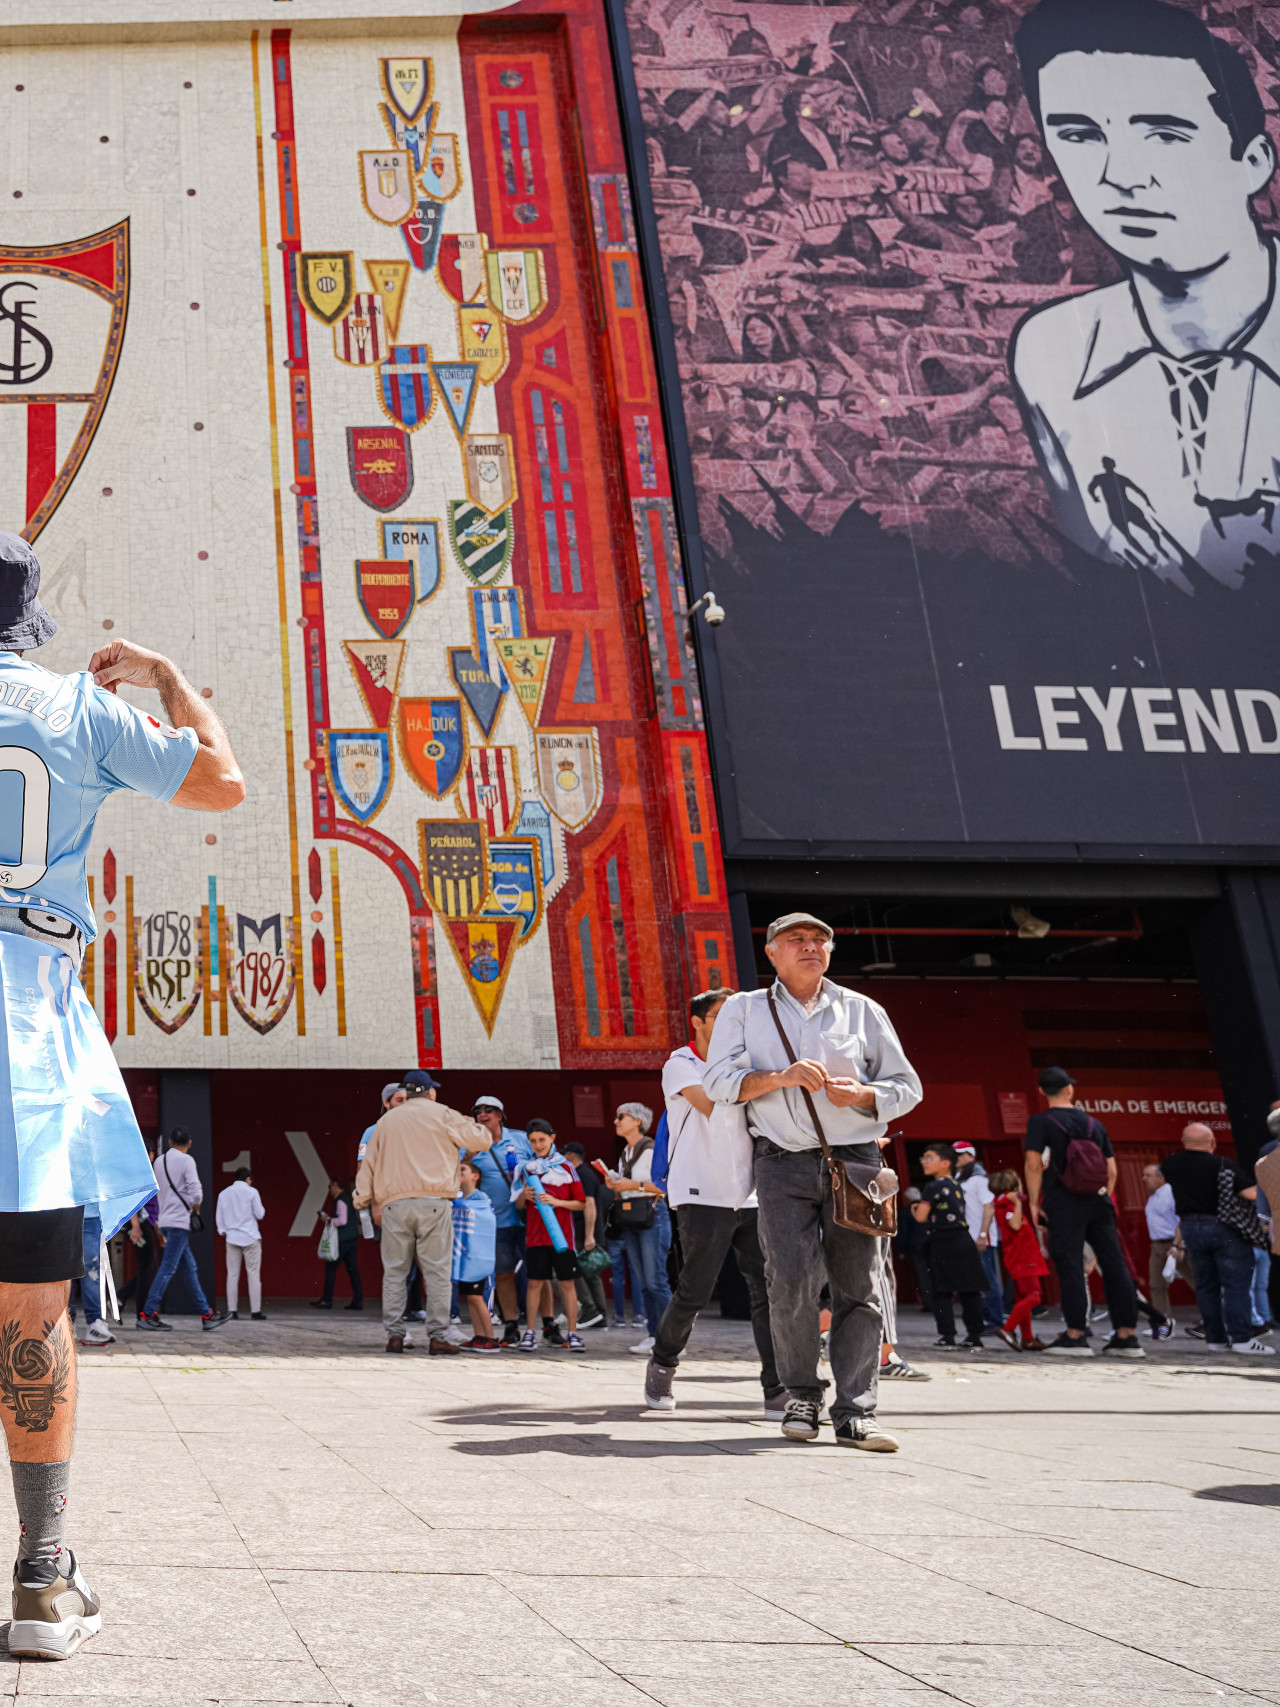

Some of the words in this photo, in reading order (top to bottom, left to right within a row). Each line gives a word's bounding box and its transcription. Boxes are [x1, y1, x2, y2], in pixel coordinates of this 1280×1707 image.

[357, 437, 401, 450] ARSENAL
[467, 444, 505, 457] SANTOS
[391, 531, 430, 545] ROMA
[365, 655, 387, 663] RIVER
[406, 717, 457, 732] HAJDUK
[430, 835, 477, 848] PEÑAROL
[143, 911, 191, 957] 1958
[236, 951, 286, 1012] 1982
[1073, 1099, 1124, 1113] ALIDA
[1127, 1099, 1150, 1114] DE
